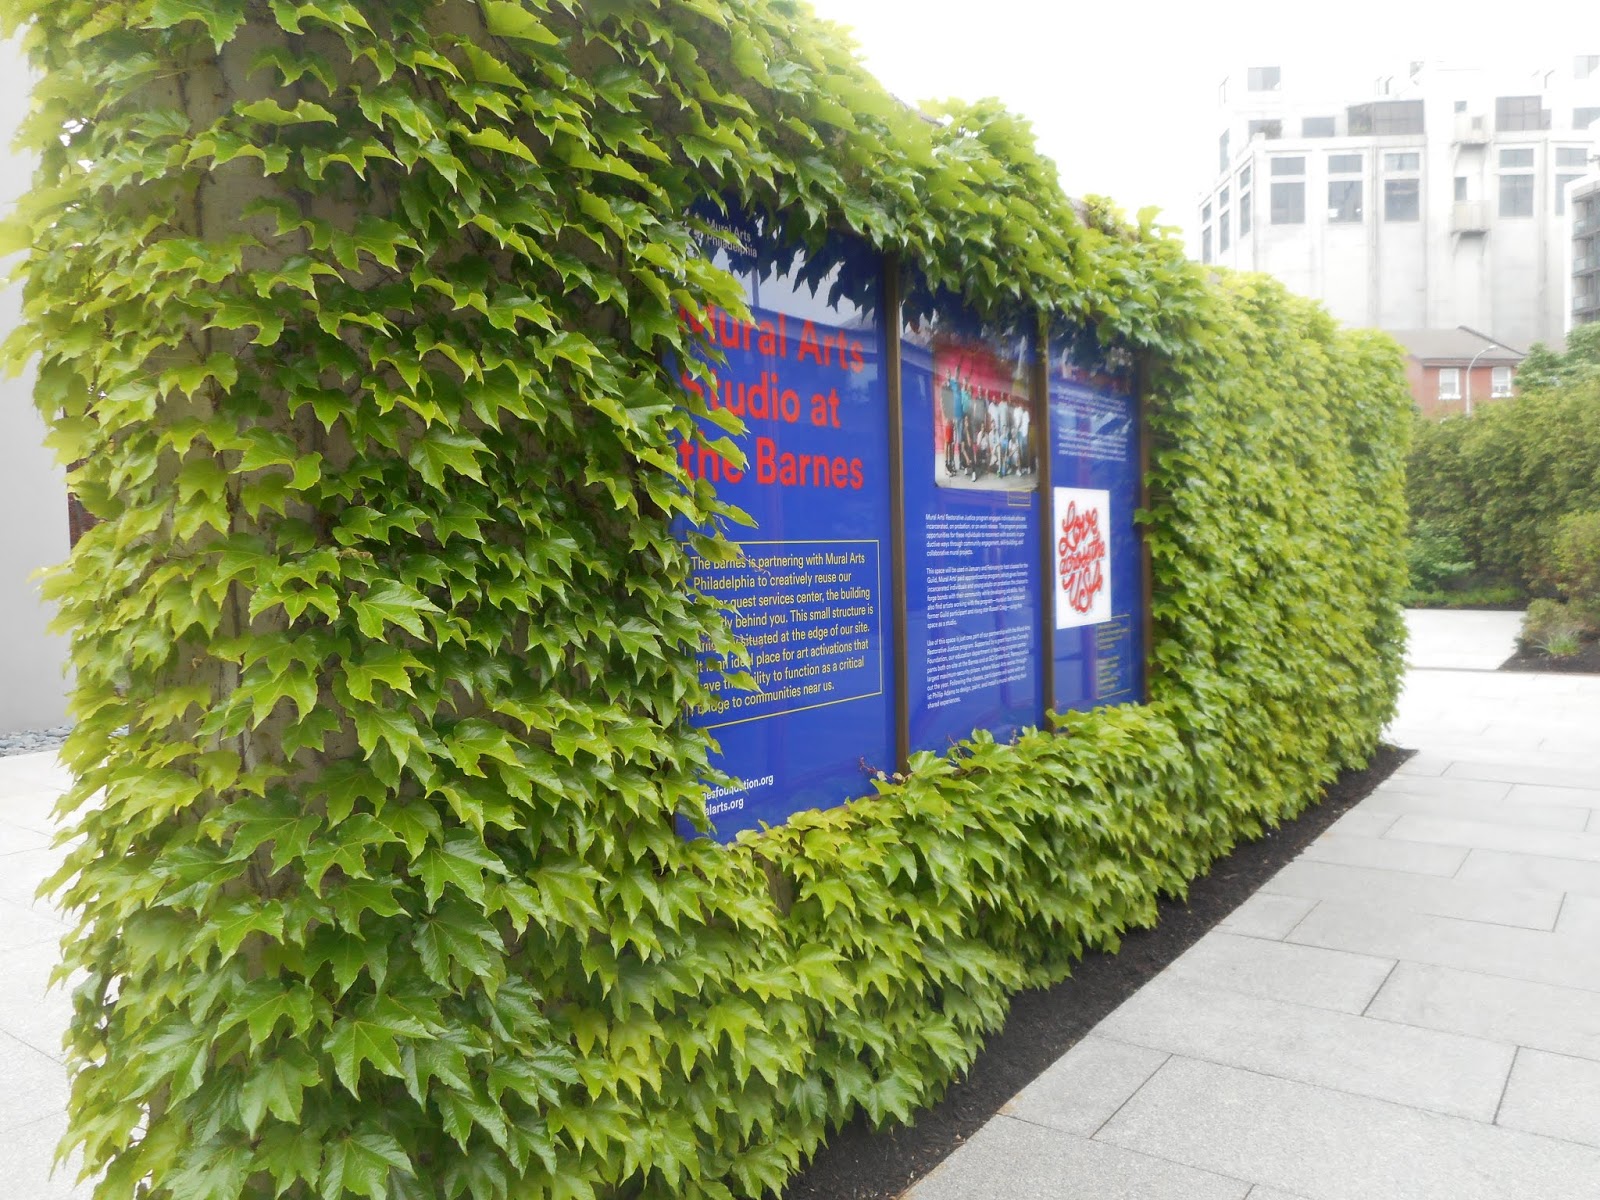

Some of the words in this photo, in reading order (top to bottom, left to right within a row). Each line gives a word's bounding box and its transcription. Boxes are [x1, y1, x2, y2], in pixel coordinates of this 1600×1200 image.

[734, 226, 751, 242] Arts
[797, 316, 864, 373] Arts
[810, 387, 842, 429] at
[678, 431, 744, 484] the
[755, 436, 864, 490] Barnes
[690, 555, 711, 571] The
[748, 554, 757, 568] is
[758, 553, 804, 569] partnering
[805, 552, 824, 566] with
[825, 552, 848, 565] Mural
[849, 552, 866, 564] Arts
[693, 575, 756, 591] Philadelphia
[757, 575, 768, 587] to
[769, 571, 813, 588] creatively
[814, 573, 837, 584] reuse
[838, 572, 852, 582] our
[730, 595, 757, 608] guest
[758, 592, 795, 606] services
[796, 590, 825, 604] center,
[826, 588, 840, 600] the
[840, 586, 871, 601] building
[735, 612, 768, 629] behind
[769, 615, 788, 628] you.
[790, 608, 808, 623] This
[809, 606, 831, 620] small
[832, 605, 866, 619] structure
[867, 603, 874, 615] is
[742, 631, 778, 648] situated
[781, 630, 790, 643] at
[792, 628, 806, 641] the
[807, 625, 828, 641] edge
[829, 623, 839, 636] of
[840, 625, 853, 636] our
[854, 620, 870, 634] site.
[756, 650, 780, 668] place
[782, 648, 795, 661] for
[796, 647, 808, 660] art
[810, 641, 852, 658] activations
[853, 638, 869, 651] that
[700, 681, 721, 692] ave
[773, 669, 783, 682] to
[785, 663, 820, 680] function
[821, 663, 831, 674] as
[832, 662, 838, 672] a
[839, 655, 865, 671] critical
[732, 696, 743, 708] to
[744, 685, 802, 706] communities
[803, 682, 822, 695] near
[823, 681, 835, 691] us.
